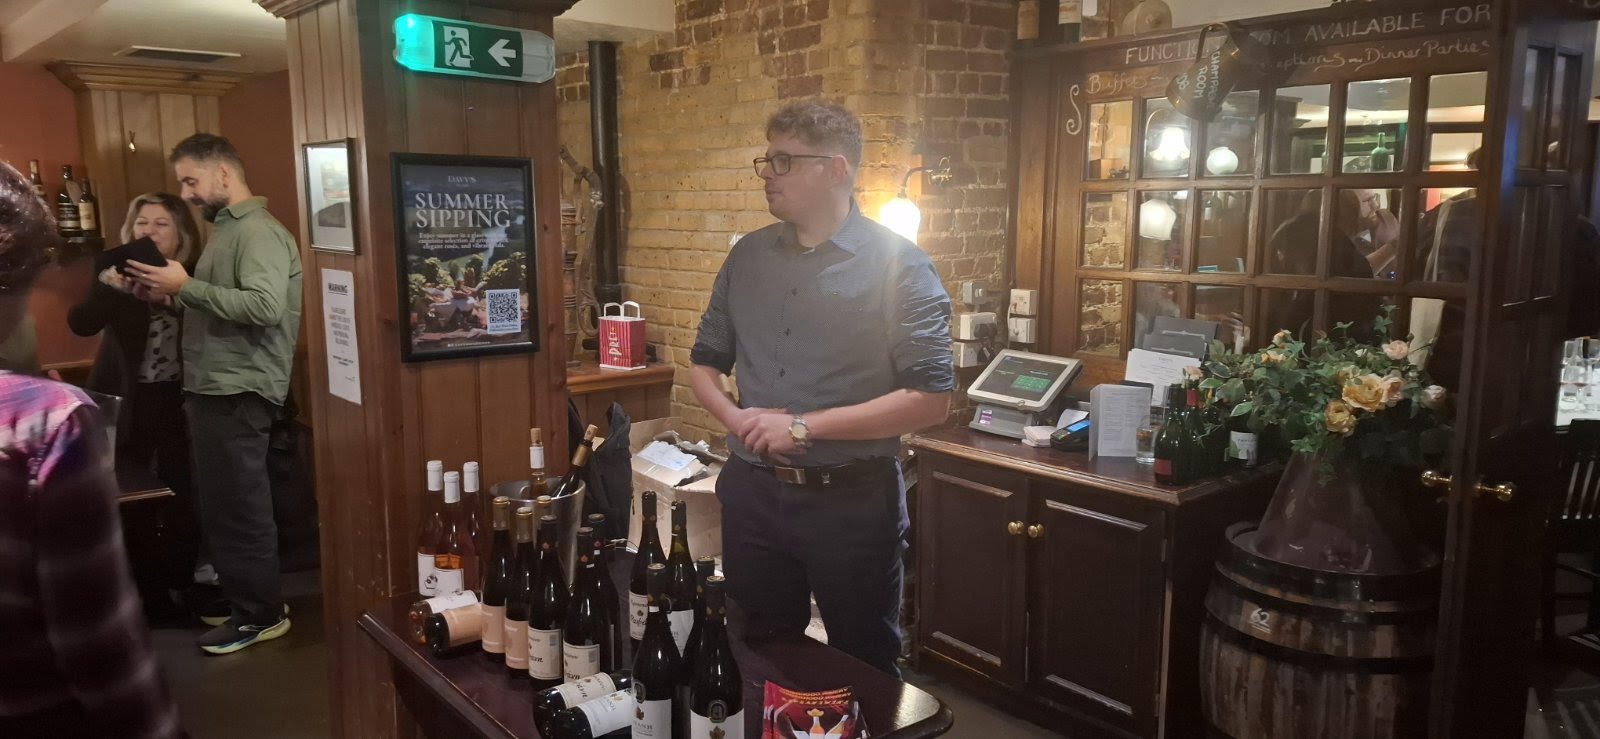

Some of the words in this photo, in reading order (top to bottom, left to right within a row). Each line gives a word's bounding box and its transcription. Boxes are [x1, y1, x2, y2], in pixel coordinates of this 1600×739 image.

[1304, 12, 1425, 41] AVAILABLE
[1440, 4, 1491, 26] FOR
[1358, 44, 1420, 68] Dinner
[1423, 39, 1490, 57] Parties
[1194, 65, 1208, 98] ROOM
[415, 193, 509, 209] SUMMER
[415, 210, 511, 228] SIPPING
[1248, 607, 1271, 628] 62
